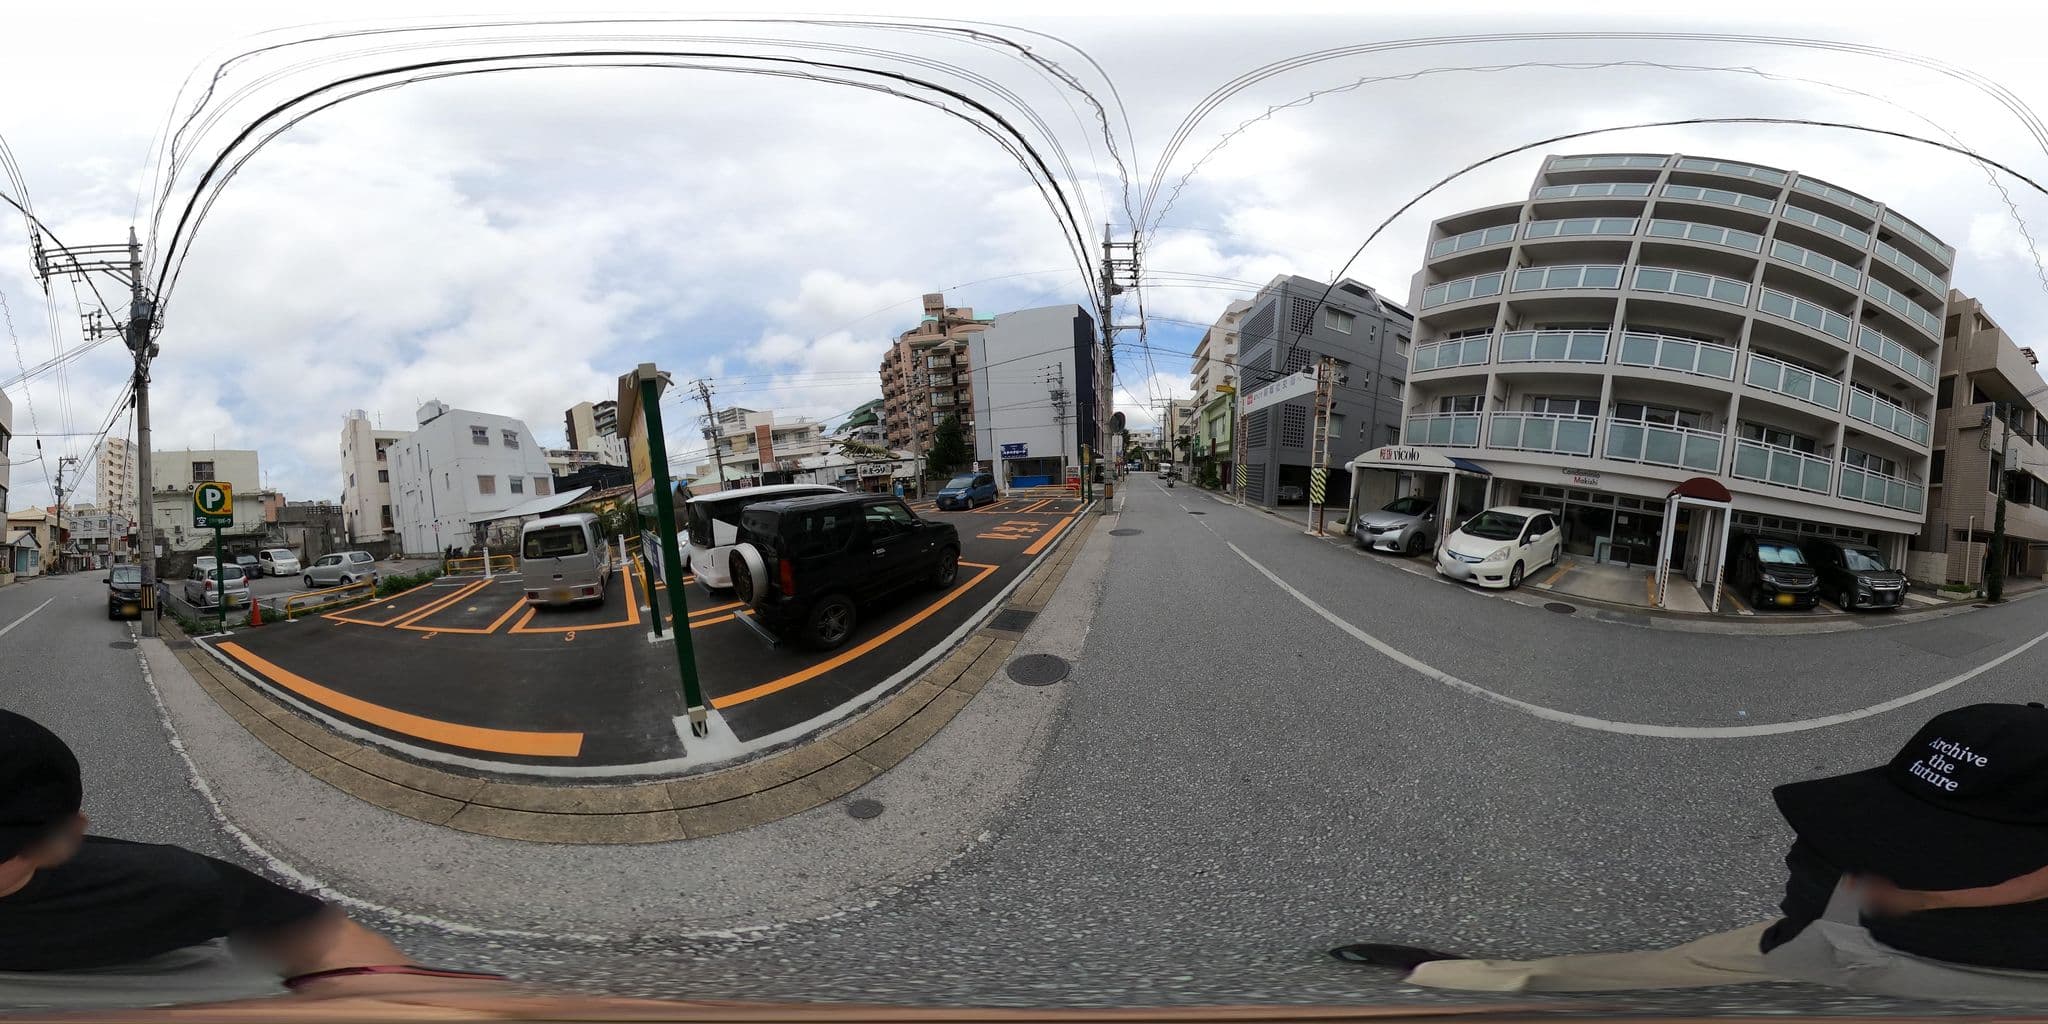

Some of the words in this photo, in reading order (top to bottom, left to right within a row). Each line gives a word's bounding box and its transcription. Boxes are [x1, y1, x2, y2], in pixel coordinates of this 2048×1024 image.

[1394, 447, 1420, 460] vicolo
[1562, 467, 1600, 479] Condominio
[1574, 476, 1599, 486] Makishi
[205, 488, 221, 509] P
[564, 631, 576, 641] 3
[1929, 737, 1988, 767] Archive
[1928, 754, 1955, 774] the
[1909, 760, 1959, 792] future
